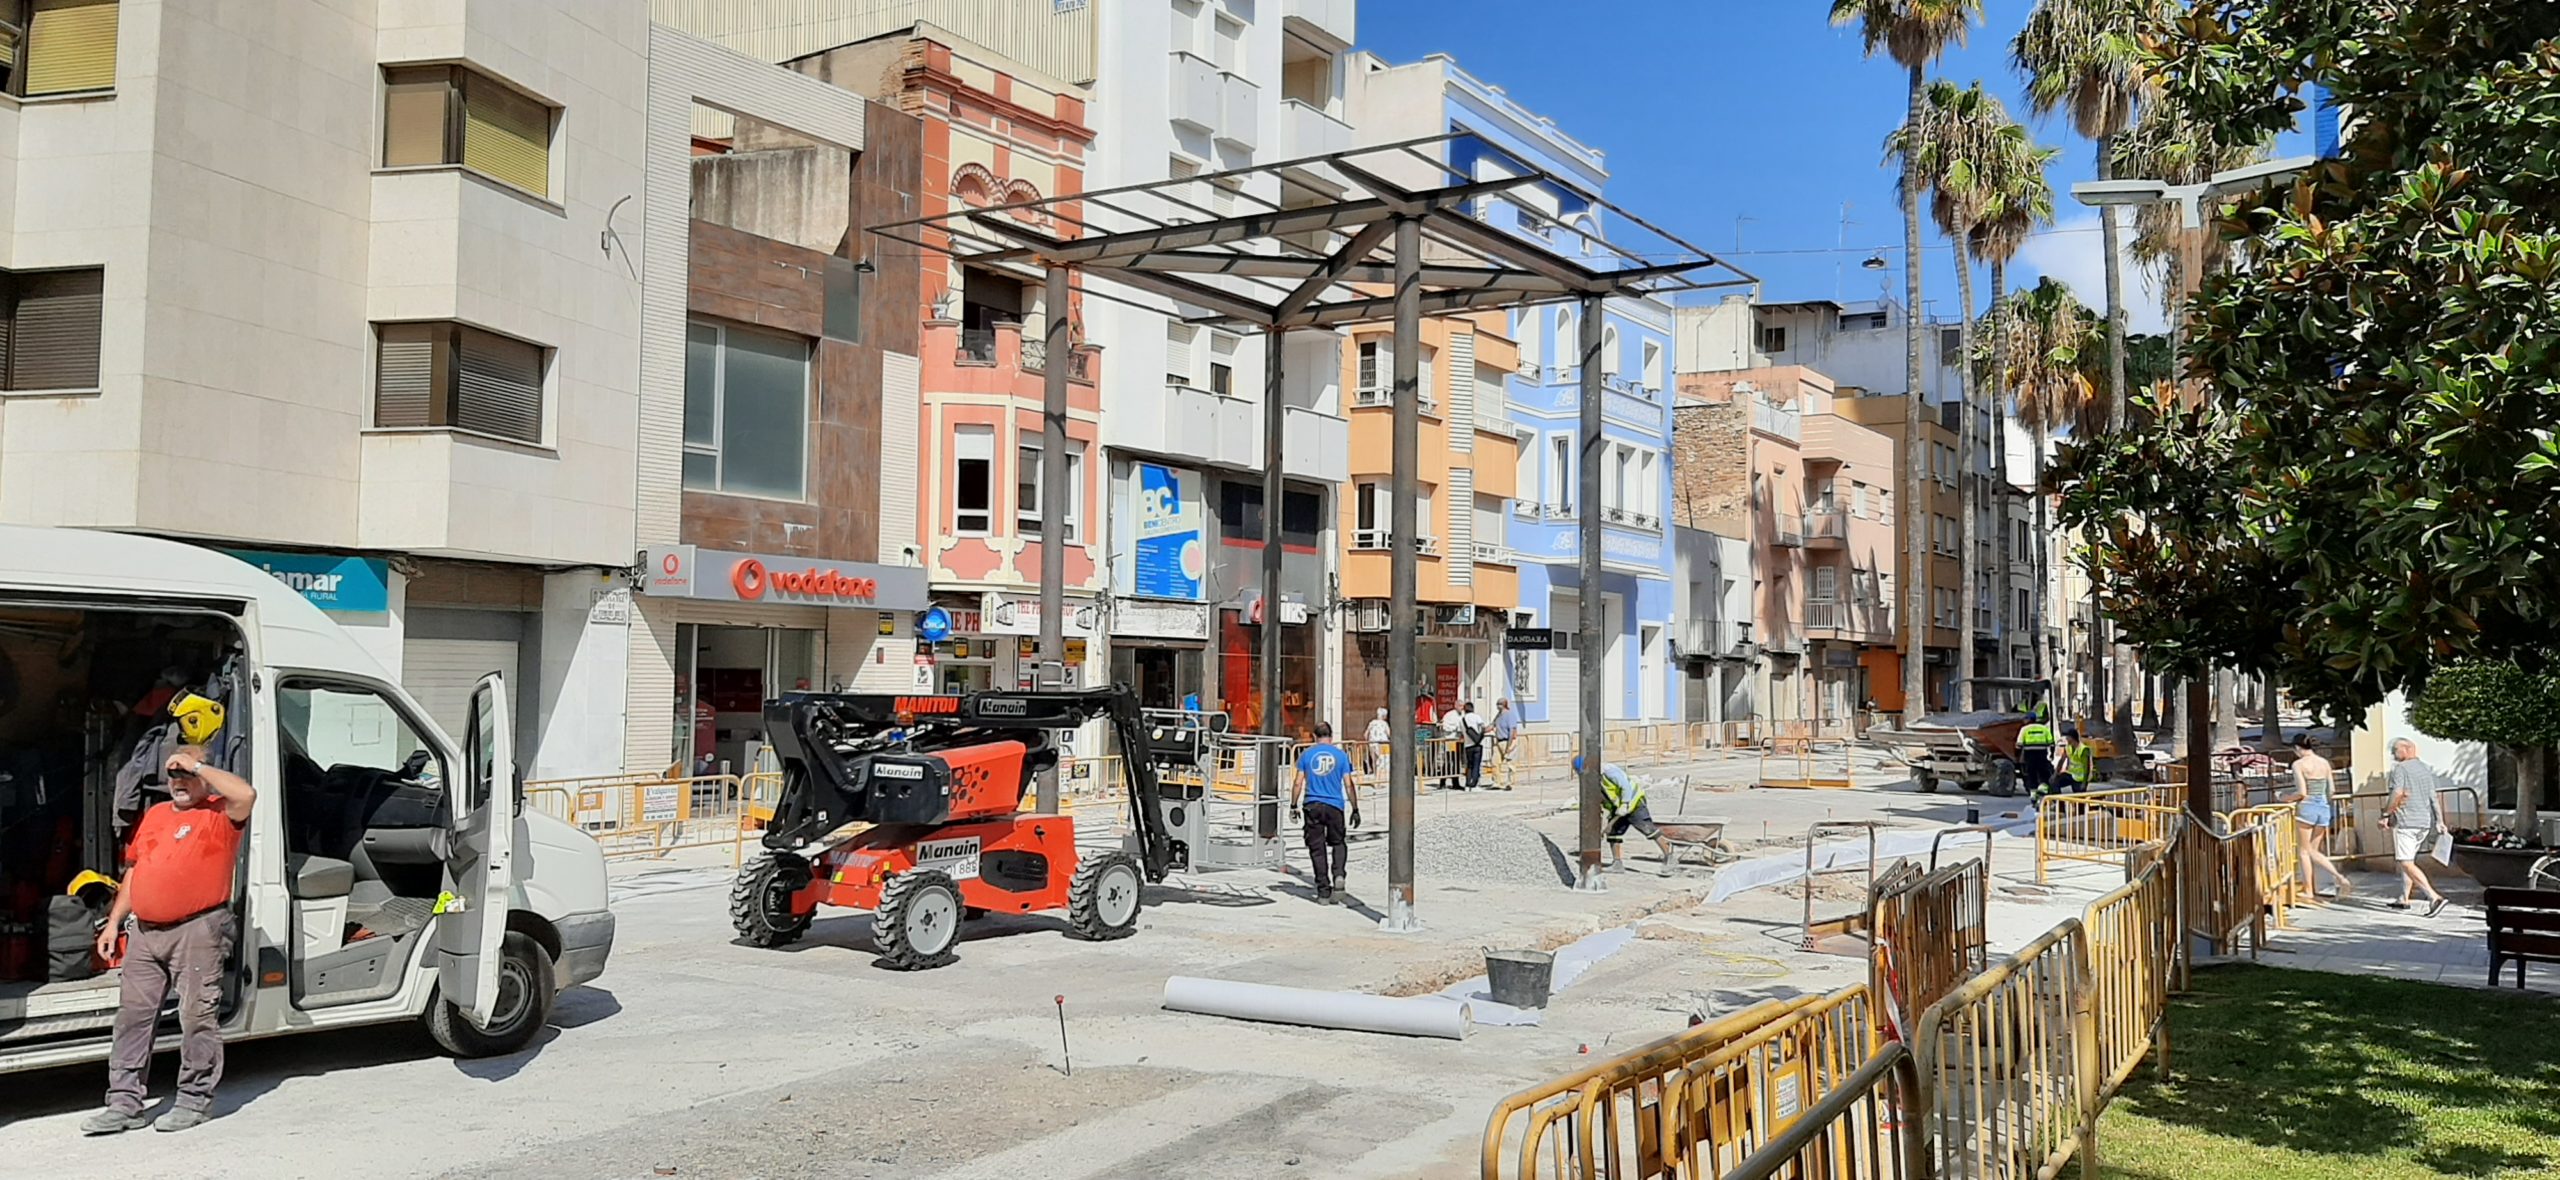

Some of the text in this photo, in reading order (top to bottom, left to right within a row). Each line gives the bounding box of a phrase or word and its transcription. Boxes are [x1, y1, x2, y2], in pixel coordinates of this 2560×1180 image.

[770, 568, 876, 598] vodafone
[893, 697, 958, 713] MANITOU
[919, 840, 978, 860] Manain
